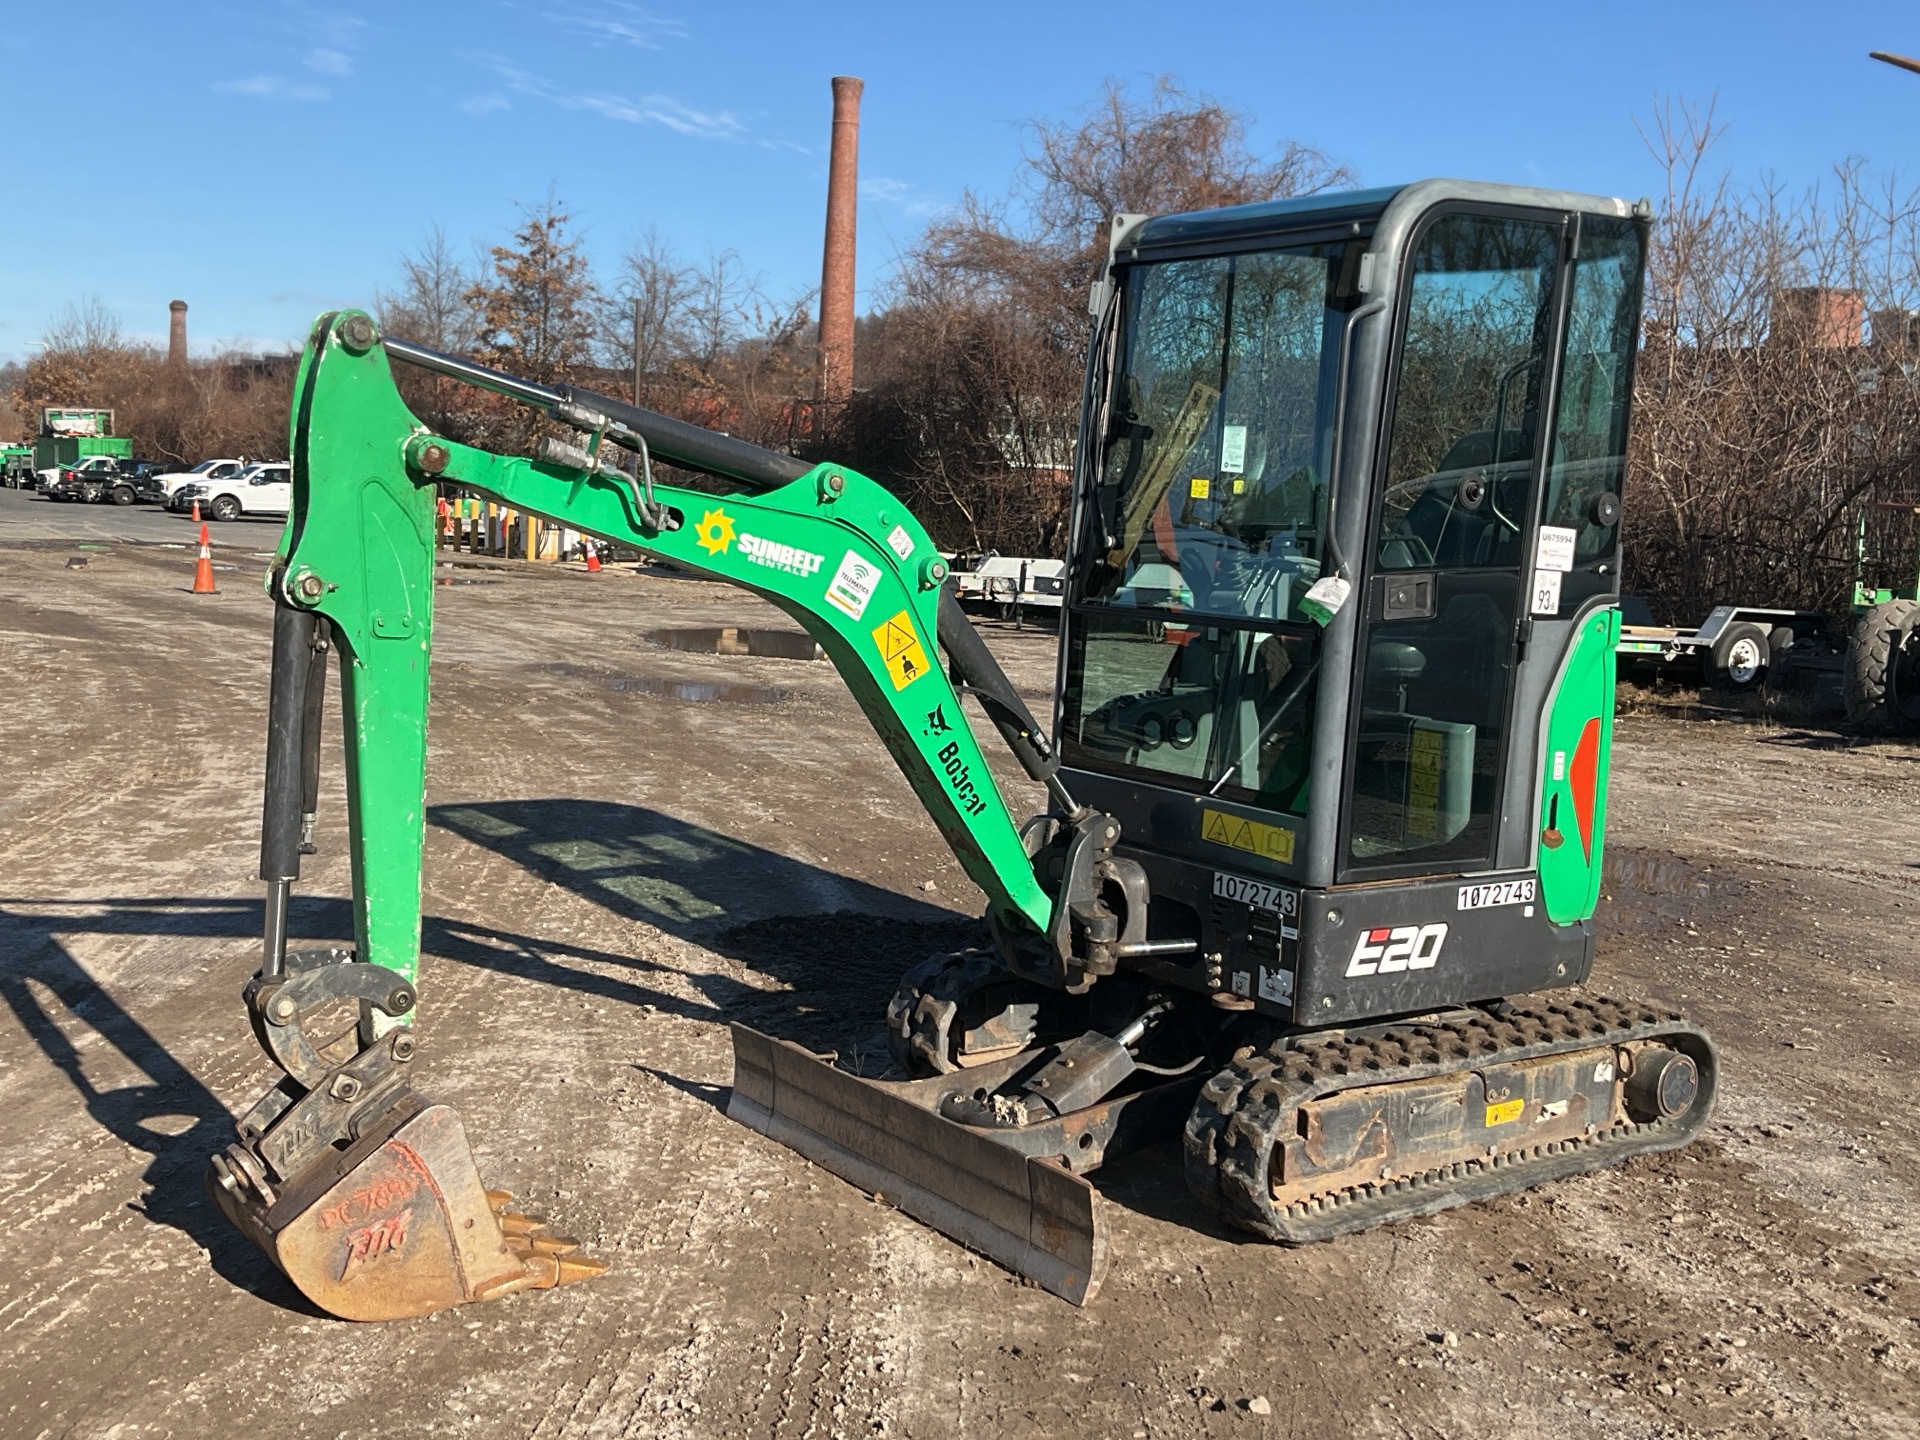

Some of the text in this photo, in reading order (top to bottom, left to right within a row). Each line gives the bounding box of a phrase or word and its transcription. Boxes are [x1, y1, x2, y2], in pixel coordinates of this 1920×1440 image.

[1542, 533, 1573, 543] U675994
[738, 532, 826, 574] SUNBELT
[747, 554, 809, 578] RENTALS
[841, 571, 869, 595] TELEMATICS
[1538, 589, 1551, 610] 93
[937, 740, 988, 817] Bobcat
[1215, 875, 1295, 914] 1072743
[1460, 881, 1533, 908] 1072743
[1344, 923, 1449, 978] E20
